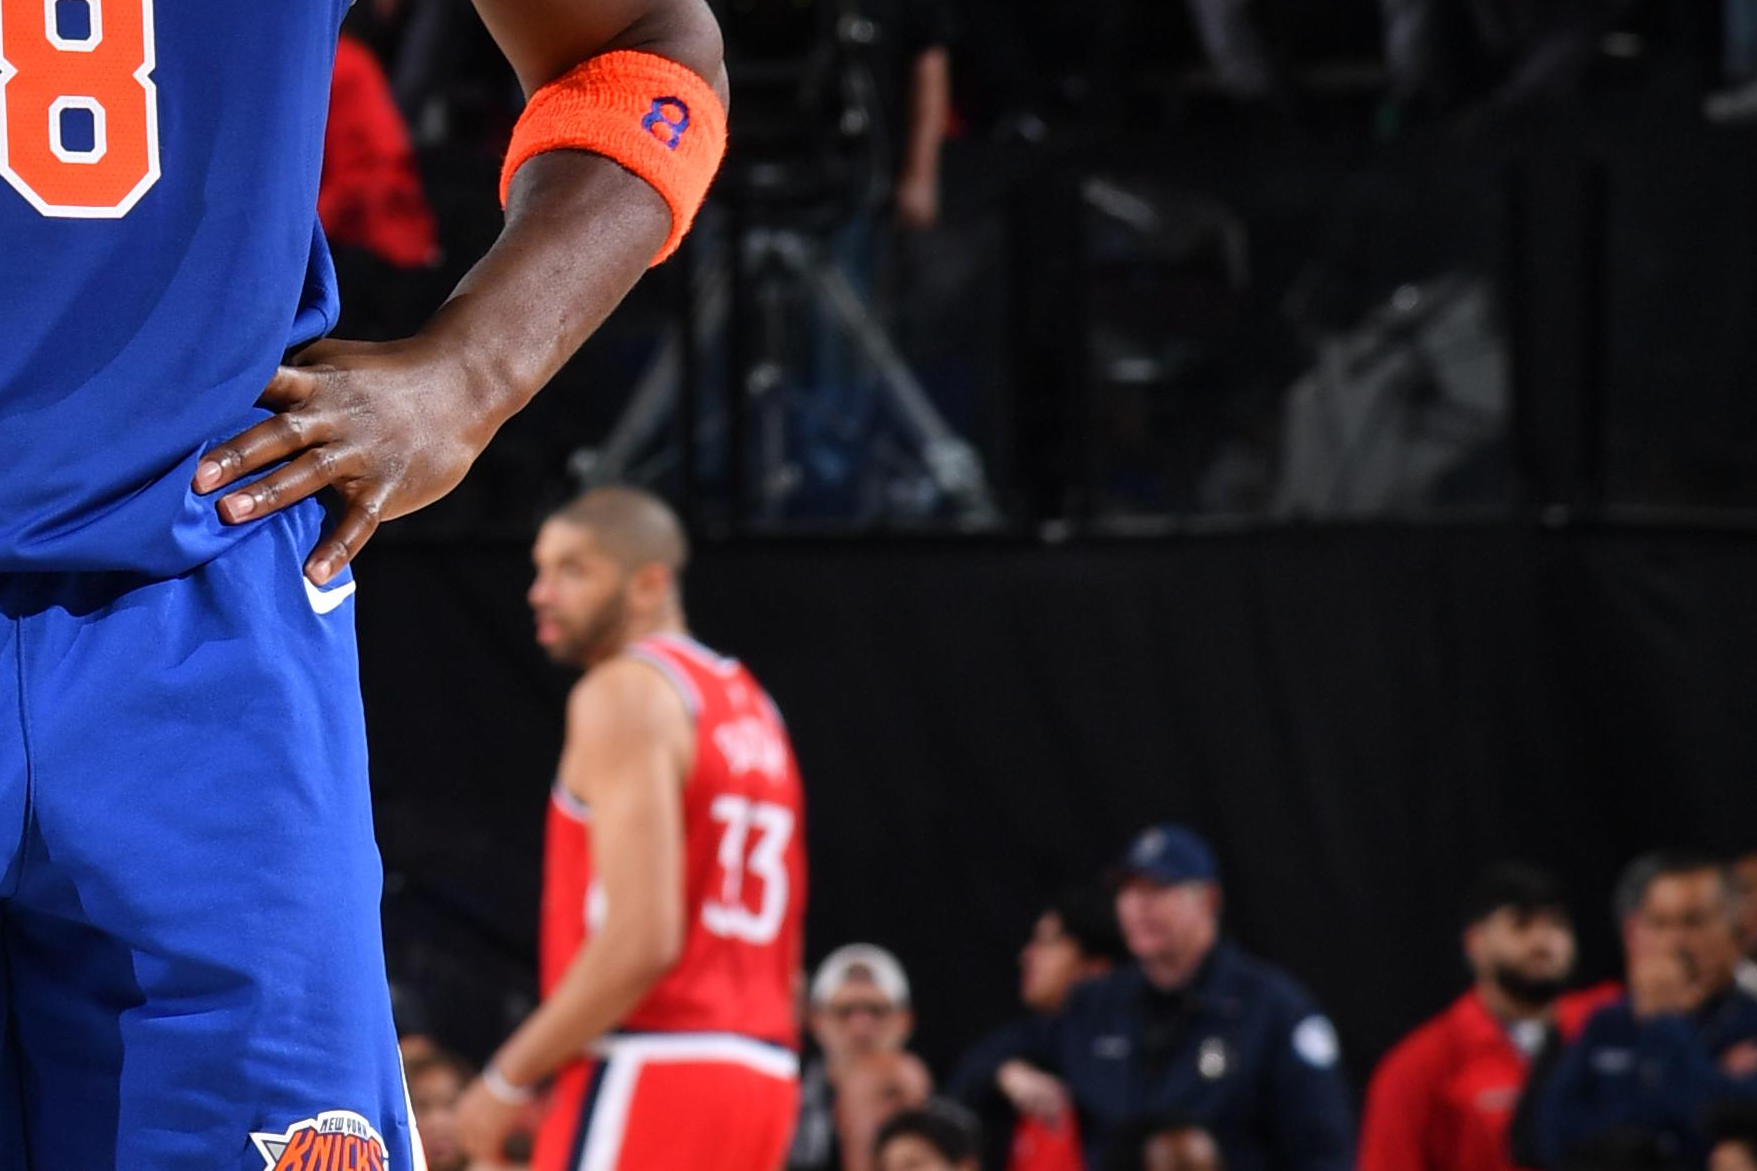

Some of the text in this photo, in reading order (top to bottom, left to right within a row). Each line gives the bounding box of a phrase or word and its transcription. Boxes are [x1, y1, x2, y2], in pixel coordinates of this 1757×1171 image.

[641, 96, 690, 151] 8
[319, 1116, 368, 1137] NEW YORK
